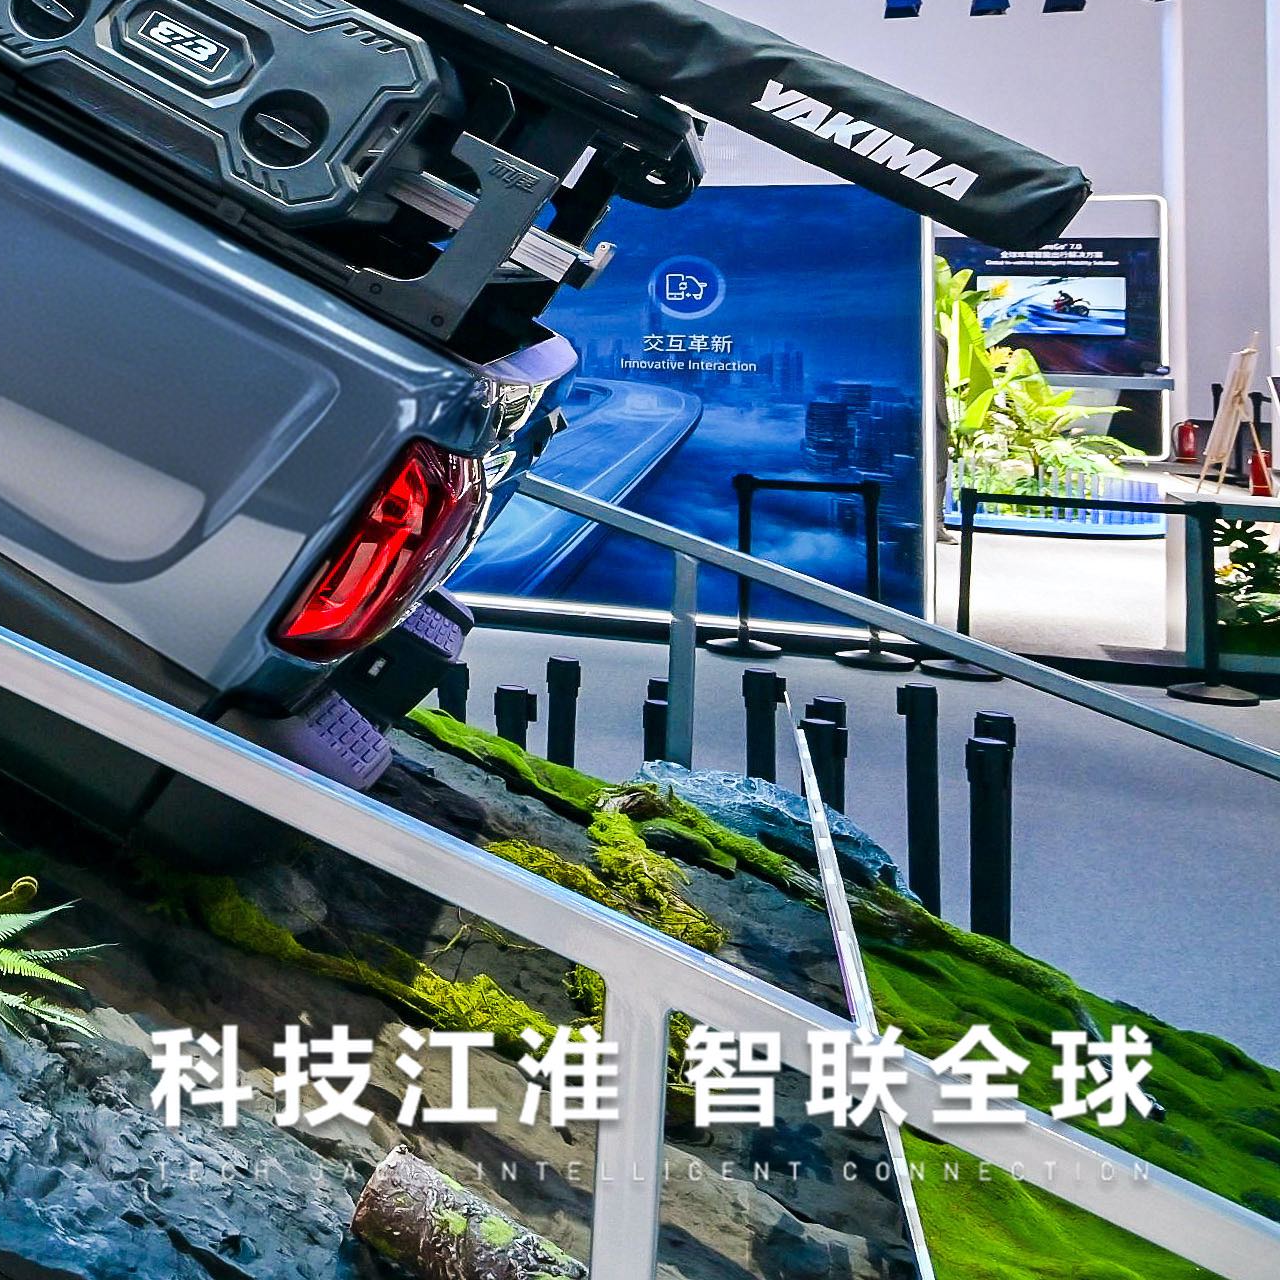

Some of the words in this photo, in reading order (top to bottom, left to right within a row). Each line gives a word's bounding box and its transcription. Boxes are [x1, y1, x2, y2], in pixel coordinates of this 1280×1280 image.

[751, 79, 979, 201] YAKIMA
[643, 333, 734, 354] 交互革新
[620, 358, 685, 371] Innovative
[688, 359, 757, 372] Interaction
